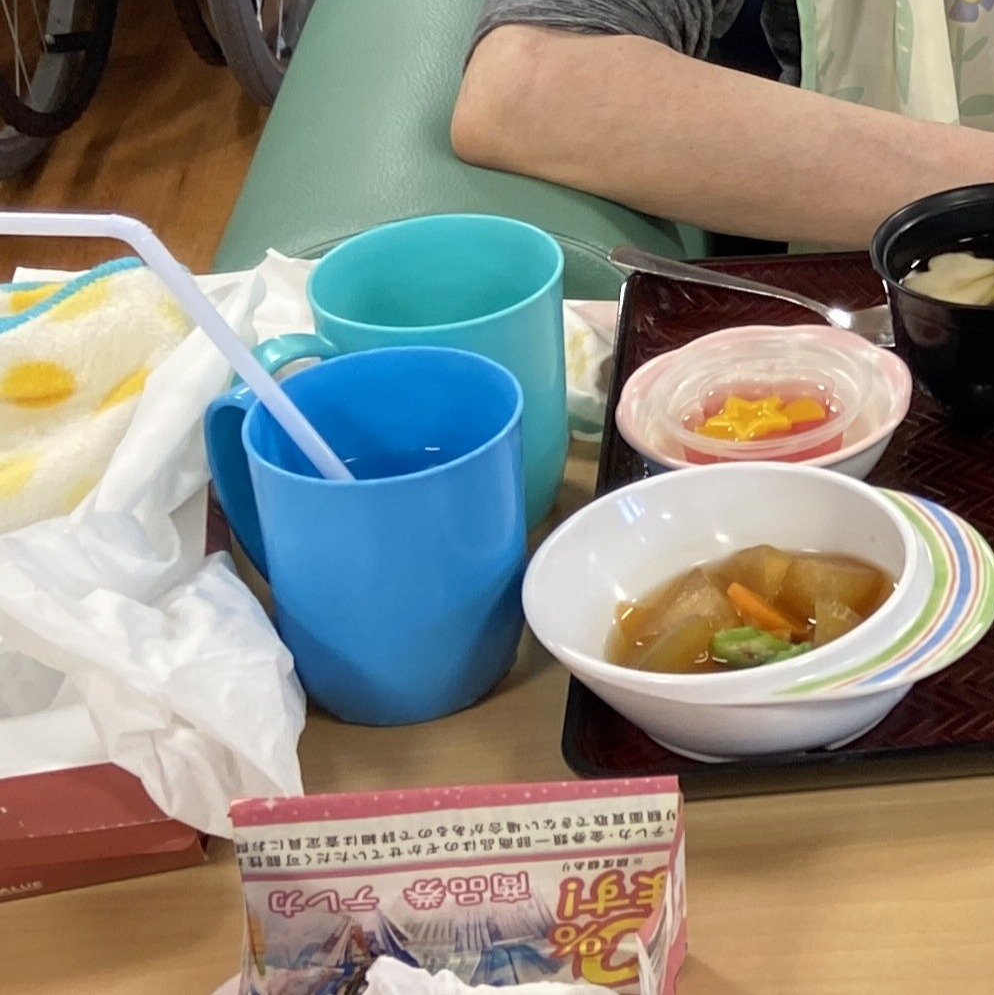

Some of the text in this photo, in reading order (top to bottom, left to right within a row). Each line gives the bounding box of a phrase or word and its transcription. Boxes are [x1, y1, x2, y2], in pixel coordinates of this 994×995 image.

[268, 870, 532, 918] テレカ 商品券
